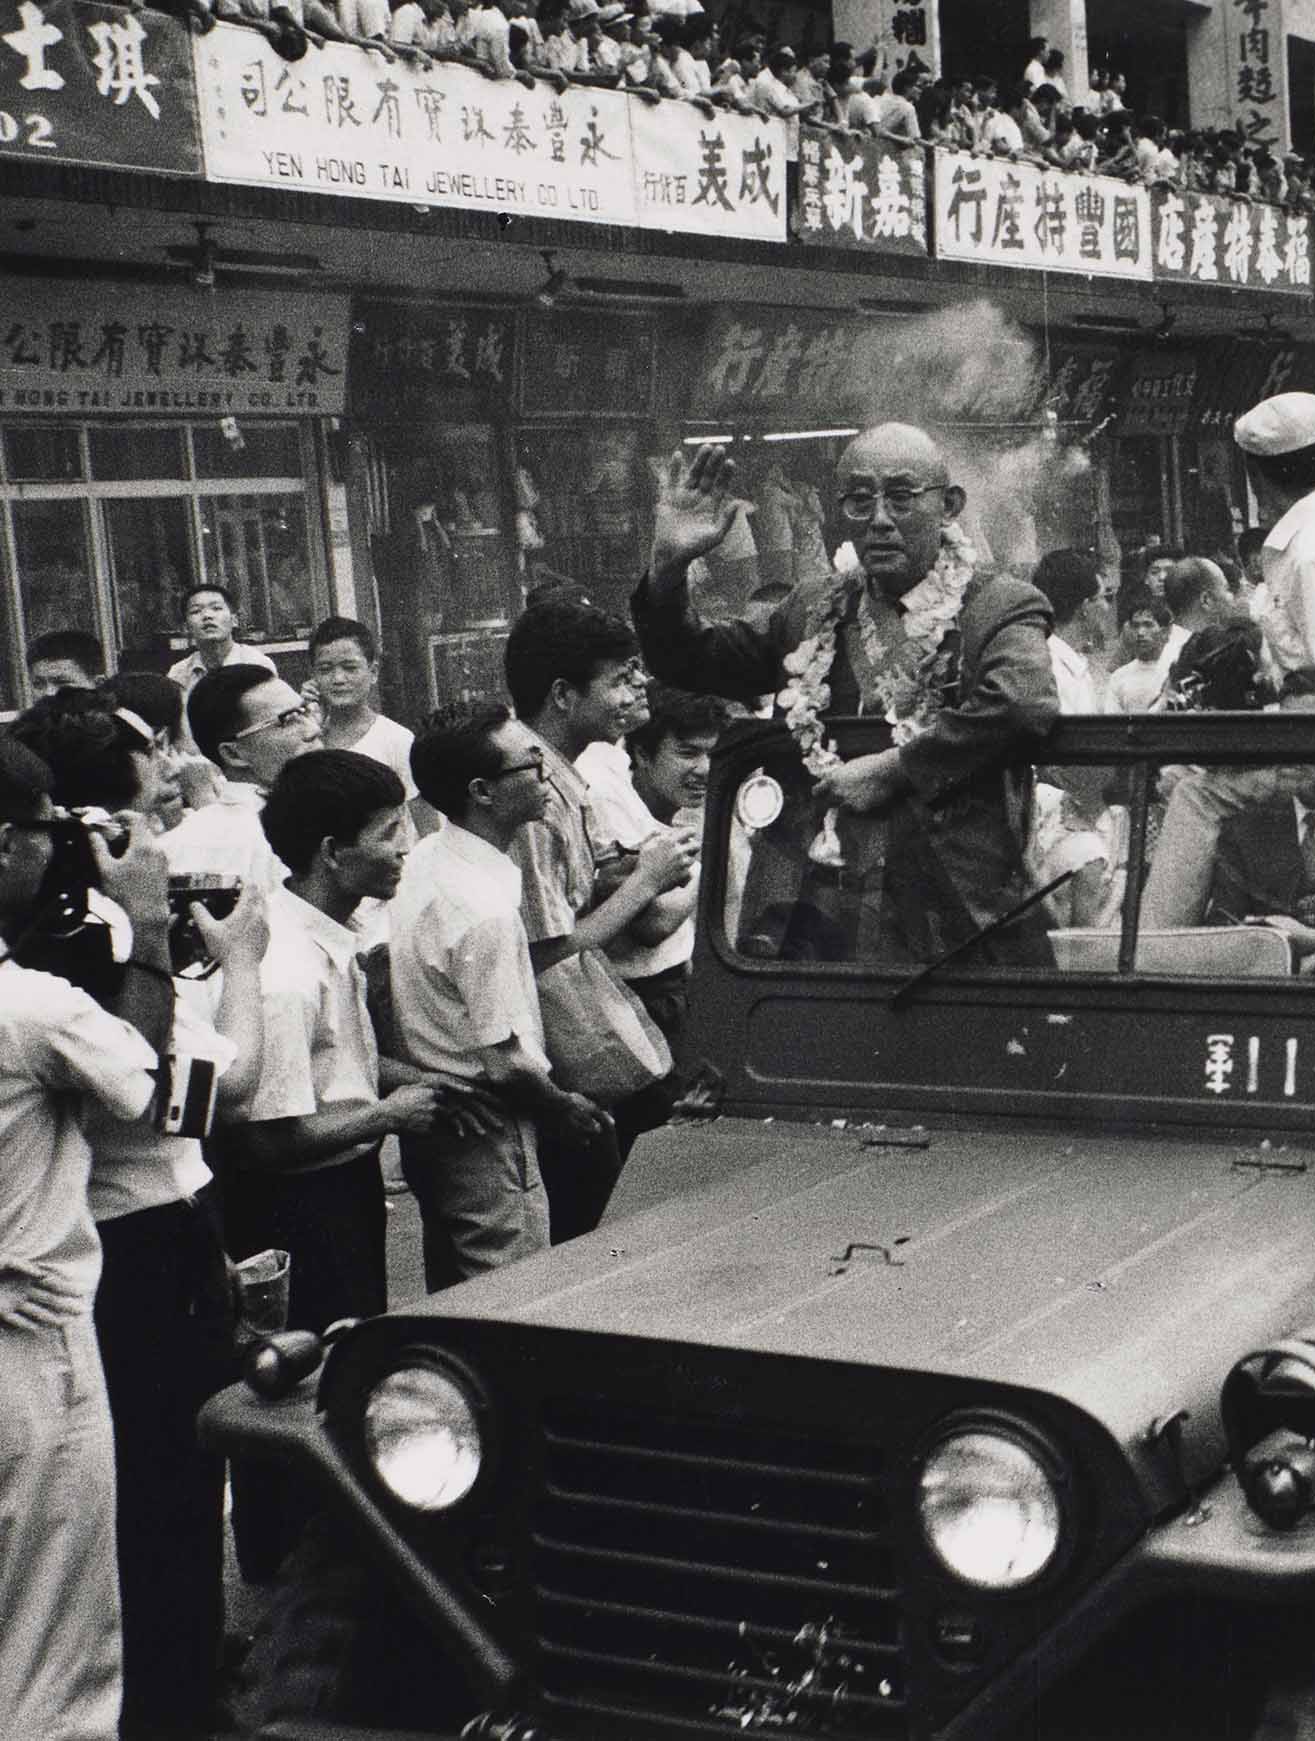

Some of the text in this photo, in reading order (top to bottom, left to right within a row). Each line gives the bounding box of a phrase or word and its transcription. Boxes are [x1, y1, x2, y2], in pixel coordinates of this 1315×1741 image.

[262, 151, 303, 178] YEN
[316, 156, 366, 185] HONG
[379, 163, 409, 190] TAI
[426, 171, 526, 201] JEWELLERY
